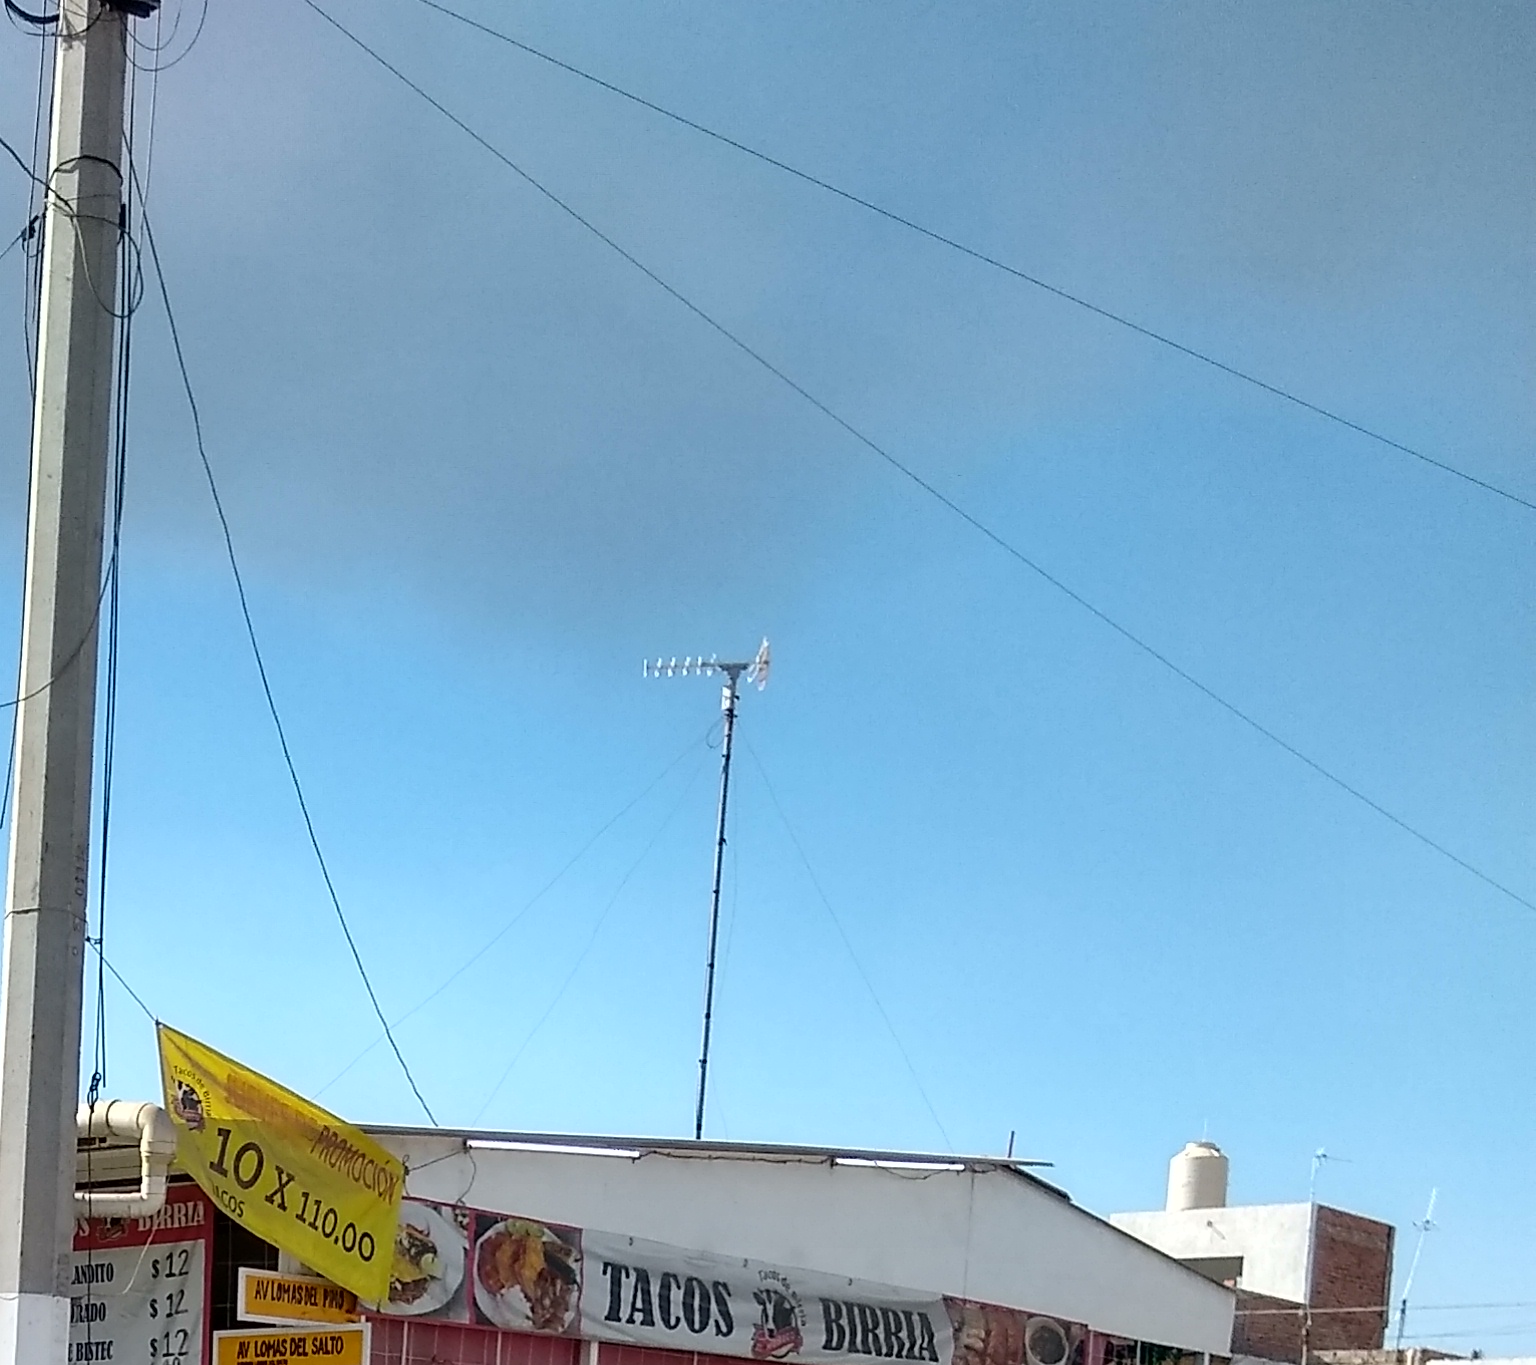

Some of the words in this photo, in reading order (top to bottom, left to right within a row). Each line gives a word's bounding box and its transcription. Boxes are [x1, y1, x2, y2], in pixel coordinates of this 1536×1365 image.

[173, 1065, 195, 1080] Tacos
[311, 1124, 400, 1206] PROMOCIÓN
[209, 1127, 264, 1190] 10
[264, 1164, 295, 1212] X
[295, 1191, 375, 1262] 110.00
[71, 1262, 114, 1285] ANDITO
[164, 1249, 189, 1278] 12
[165, 1289, 188, 1318] 12
[254, 1279, 270, 1300] AV
[271, 1280, 303, 1305] LOMAS
[304, 1285, 319, 1307] DEL
[602, 1261, 734, 1338] TACOS
[818, 1296, 940, 1363] BIRRIA
[75, 1340, 114, 1362] BISTEC
[162, 1329, 189, 1357] 12
[237, 1340, 251, 1360] AV
[254, 1337, 288, 1359] LOMAS
[289, 1336, 309, 1357] DEL
[311, 1336, 344, 1355] SALTO
